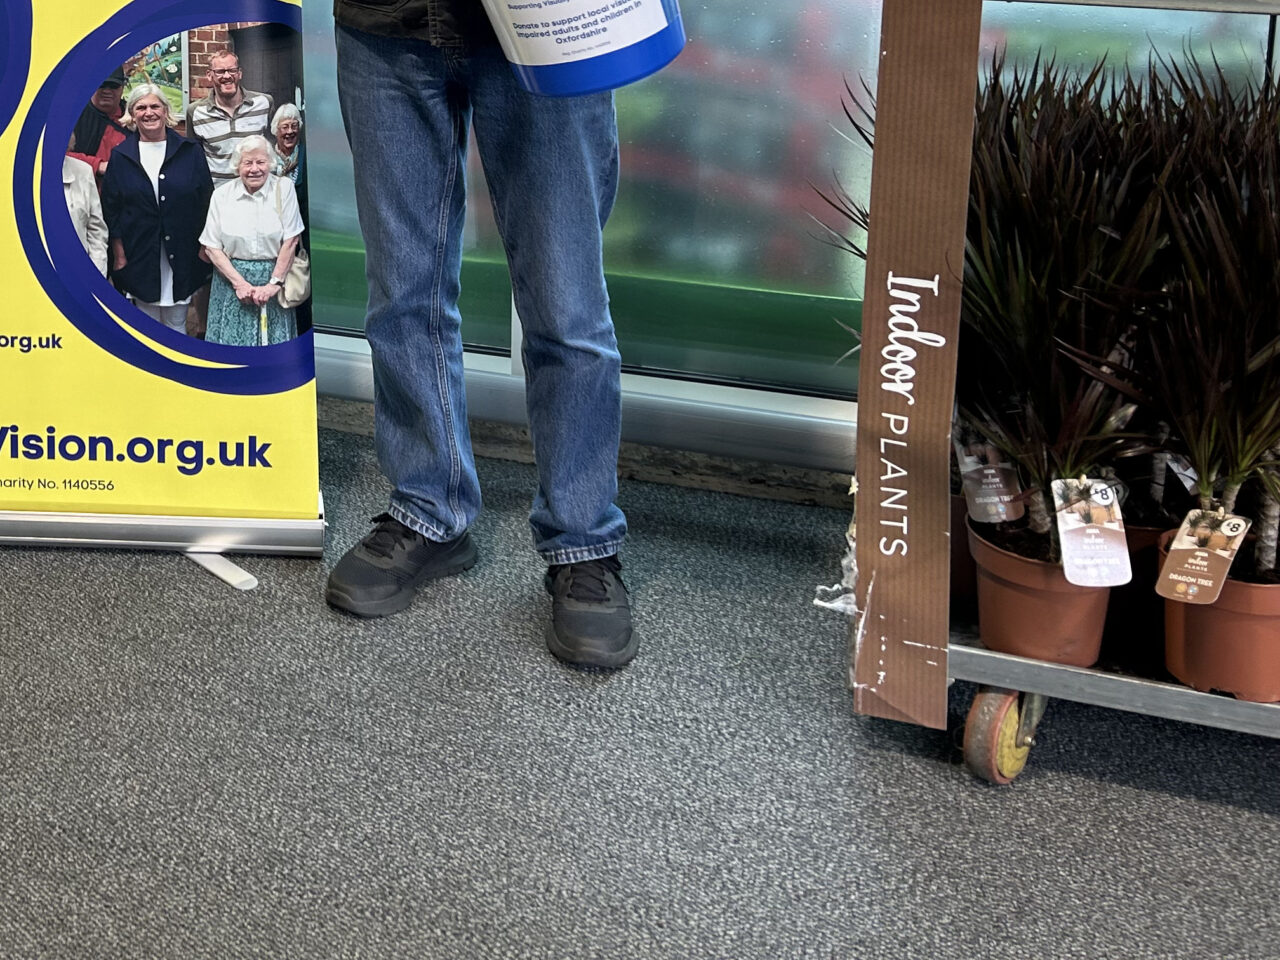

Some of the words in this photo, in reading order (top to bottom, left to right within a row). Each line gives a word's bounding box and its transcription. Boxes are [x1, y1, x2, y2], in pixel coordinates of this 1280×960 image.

[512, 21, 540, 30] Donate
[541, 21, 550, 29] to
[551, 13, 587, 27] support
[587, 5, 610, 17] local
[516, 30, 551, 39] impaired
[551, 23, 580, 36] adults
[581, 18, 599, 30] and
[600, 5, 634, 23] children
[634, 0, 642, 9] in
[555, 26, 608, 45] Oxfordshire
[880, 270, 946, 405] Indoor
[37, 477, 59, 490] No.
[61, 478, 115, 491] 1140556
[879, 411, 909, 559] PLANTS
